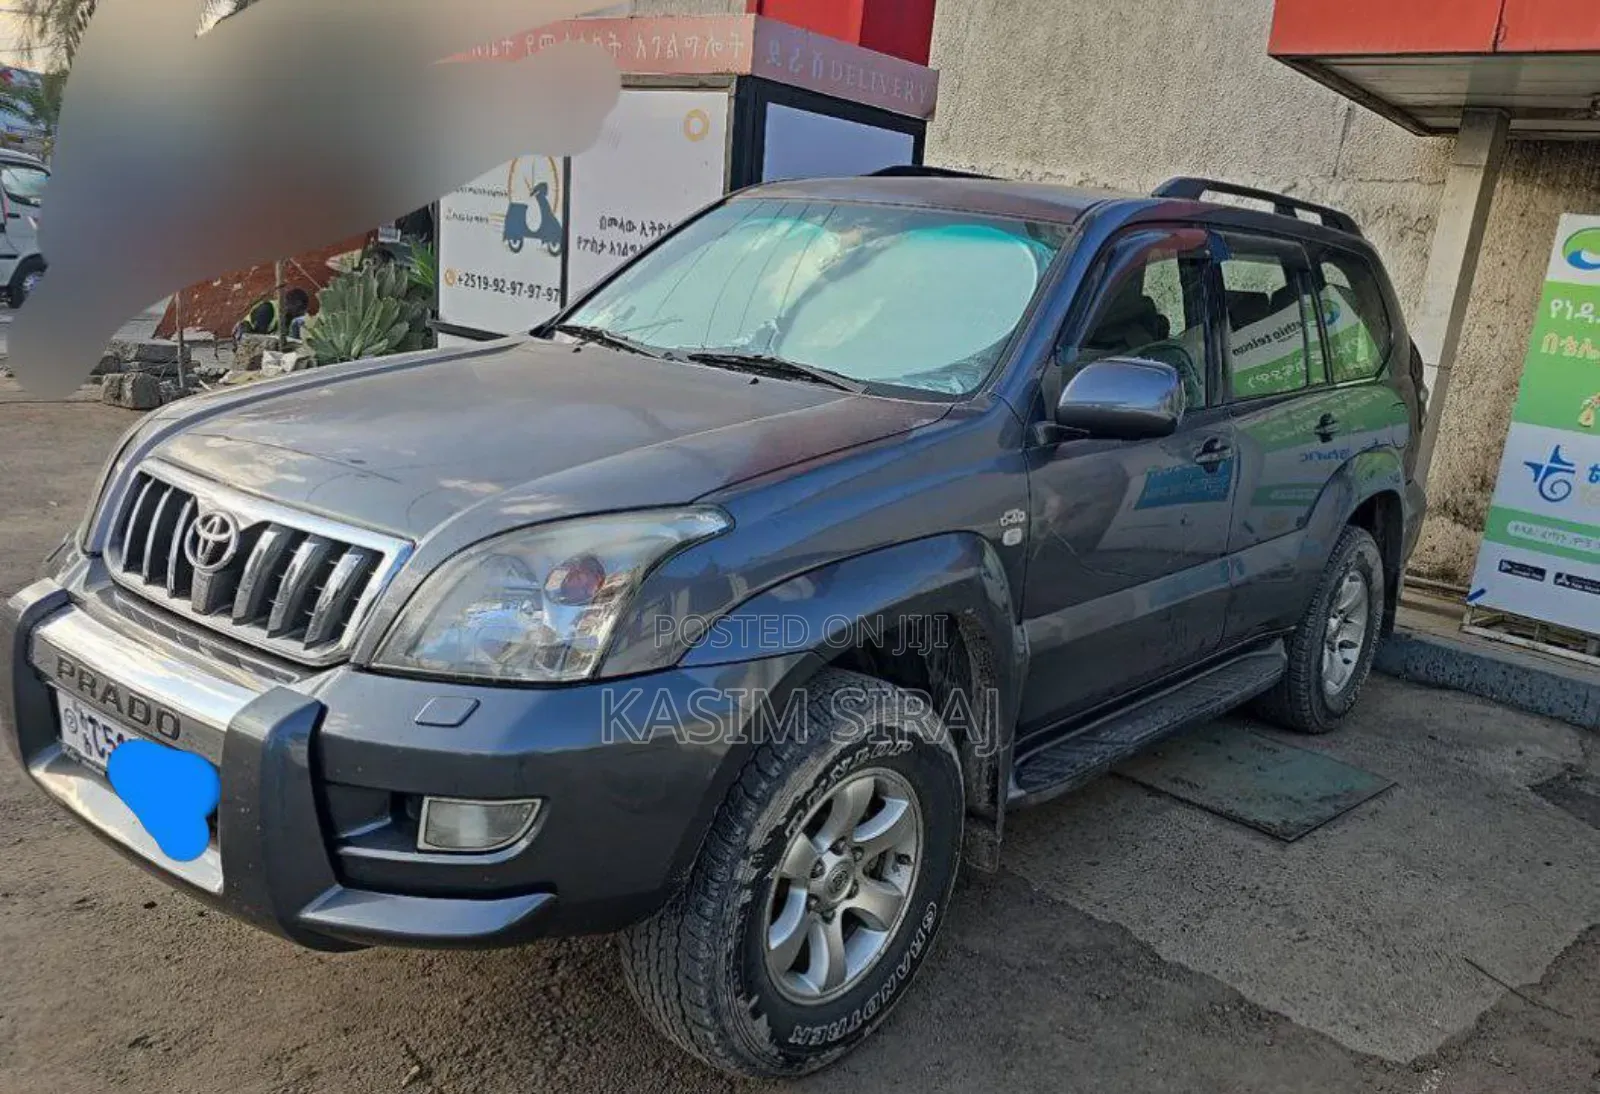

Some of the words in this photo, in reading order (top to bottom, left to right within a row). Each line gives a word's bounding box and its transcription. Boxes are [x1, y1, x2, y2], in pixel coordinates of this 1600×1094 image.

[830, 59, 930, 104] DELIVERY
[640, 219, 674, 237] ኢትዮ
[457, 272, 559, 302] +2519-92-97-97-97
[1550, 297, 1600, 324] የነዳ
[56, 655, 181, 741] PRADO
